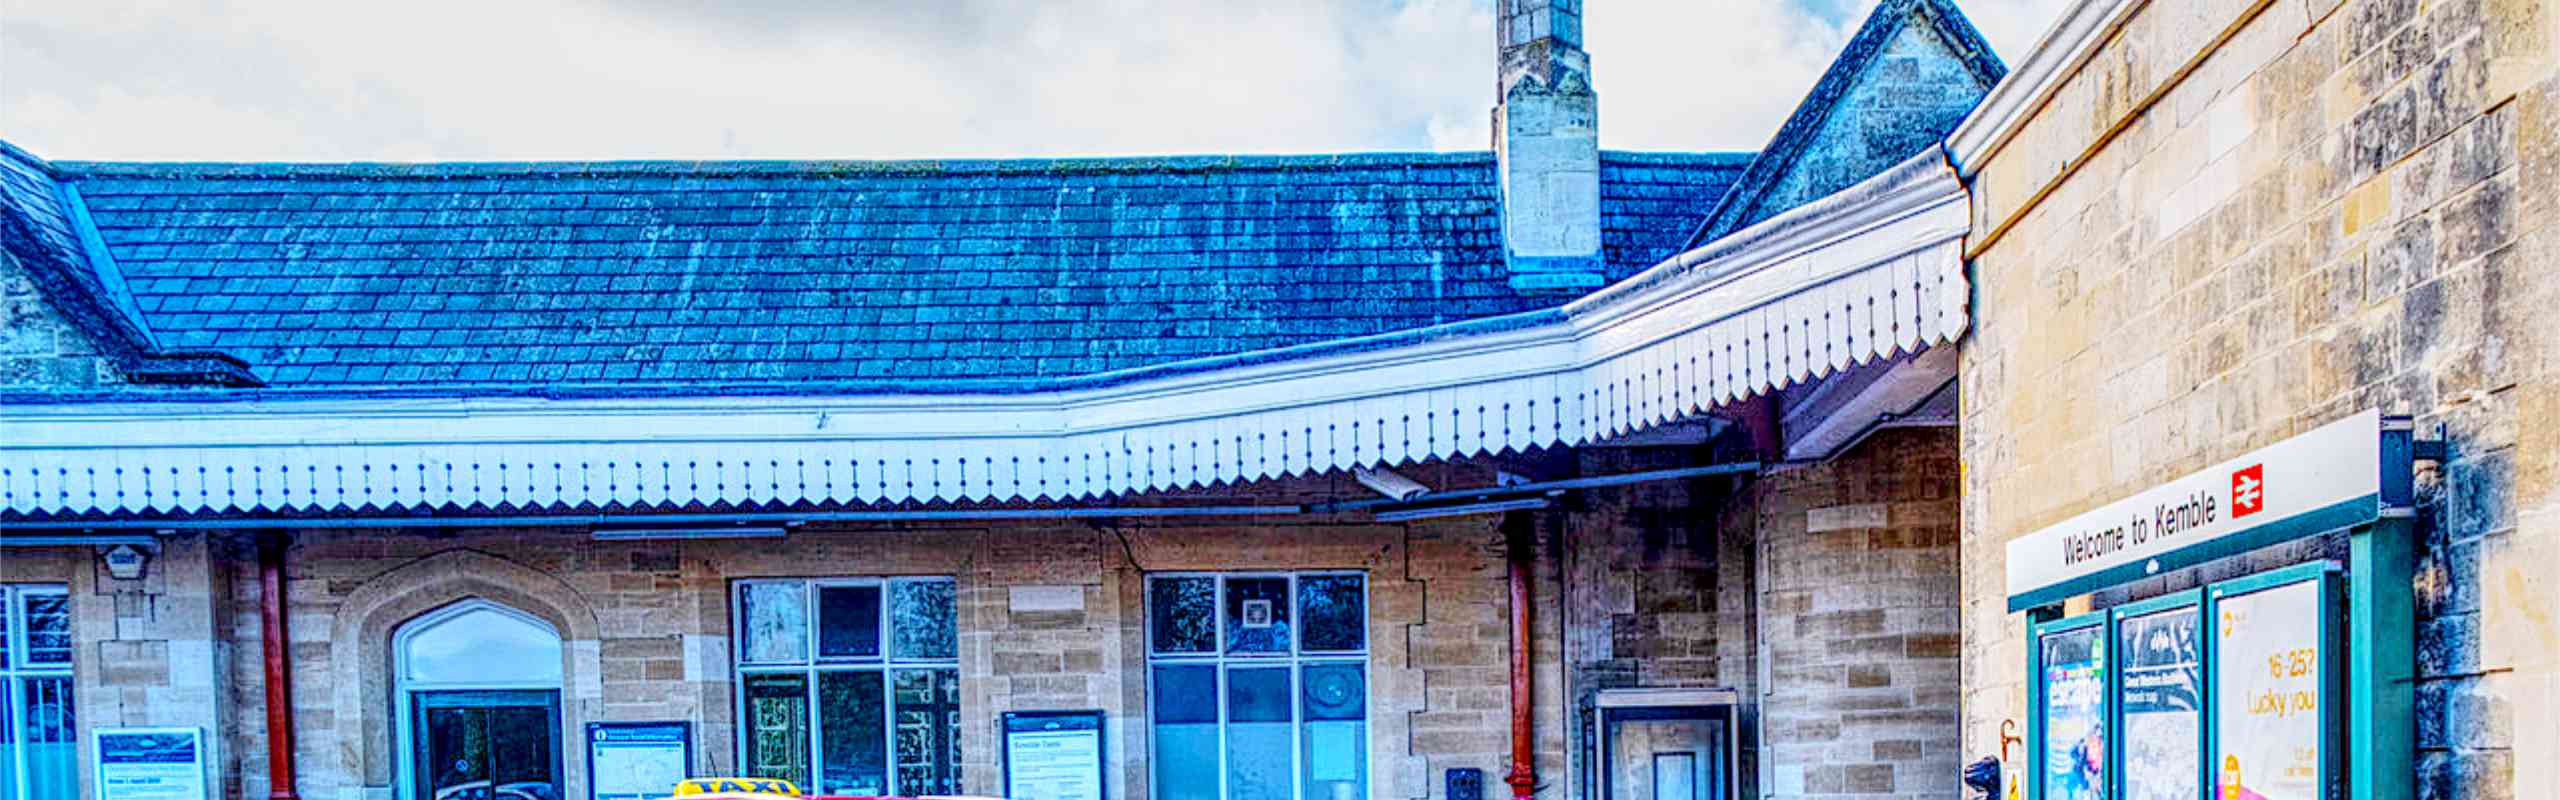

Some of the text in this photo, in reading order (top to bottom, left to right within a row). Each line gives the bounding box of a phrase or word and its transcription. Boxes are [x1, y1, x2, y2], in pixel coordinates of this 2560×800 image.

[2063, 490, 2216, 566] Welcome to Kemble
[2267, 647, 2315, 679] 16-25?
[2247, 688, 2315, 718] Lucky you
[689, 780, 792, 794] TAXI
